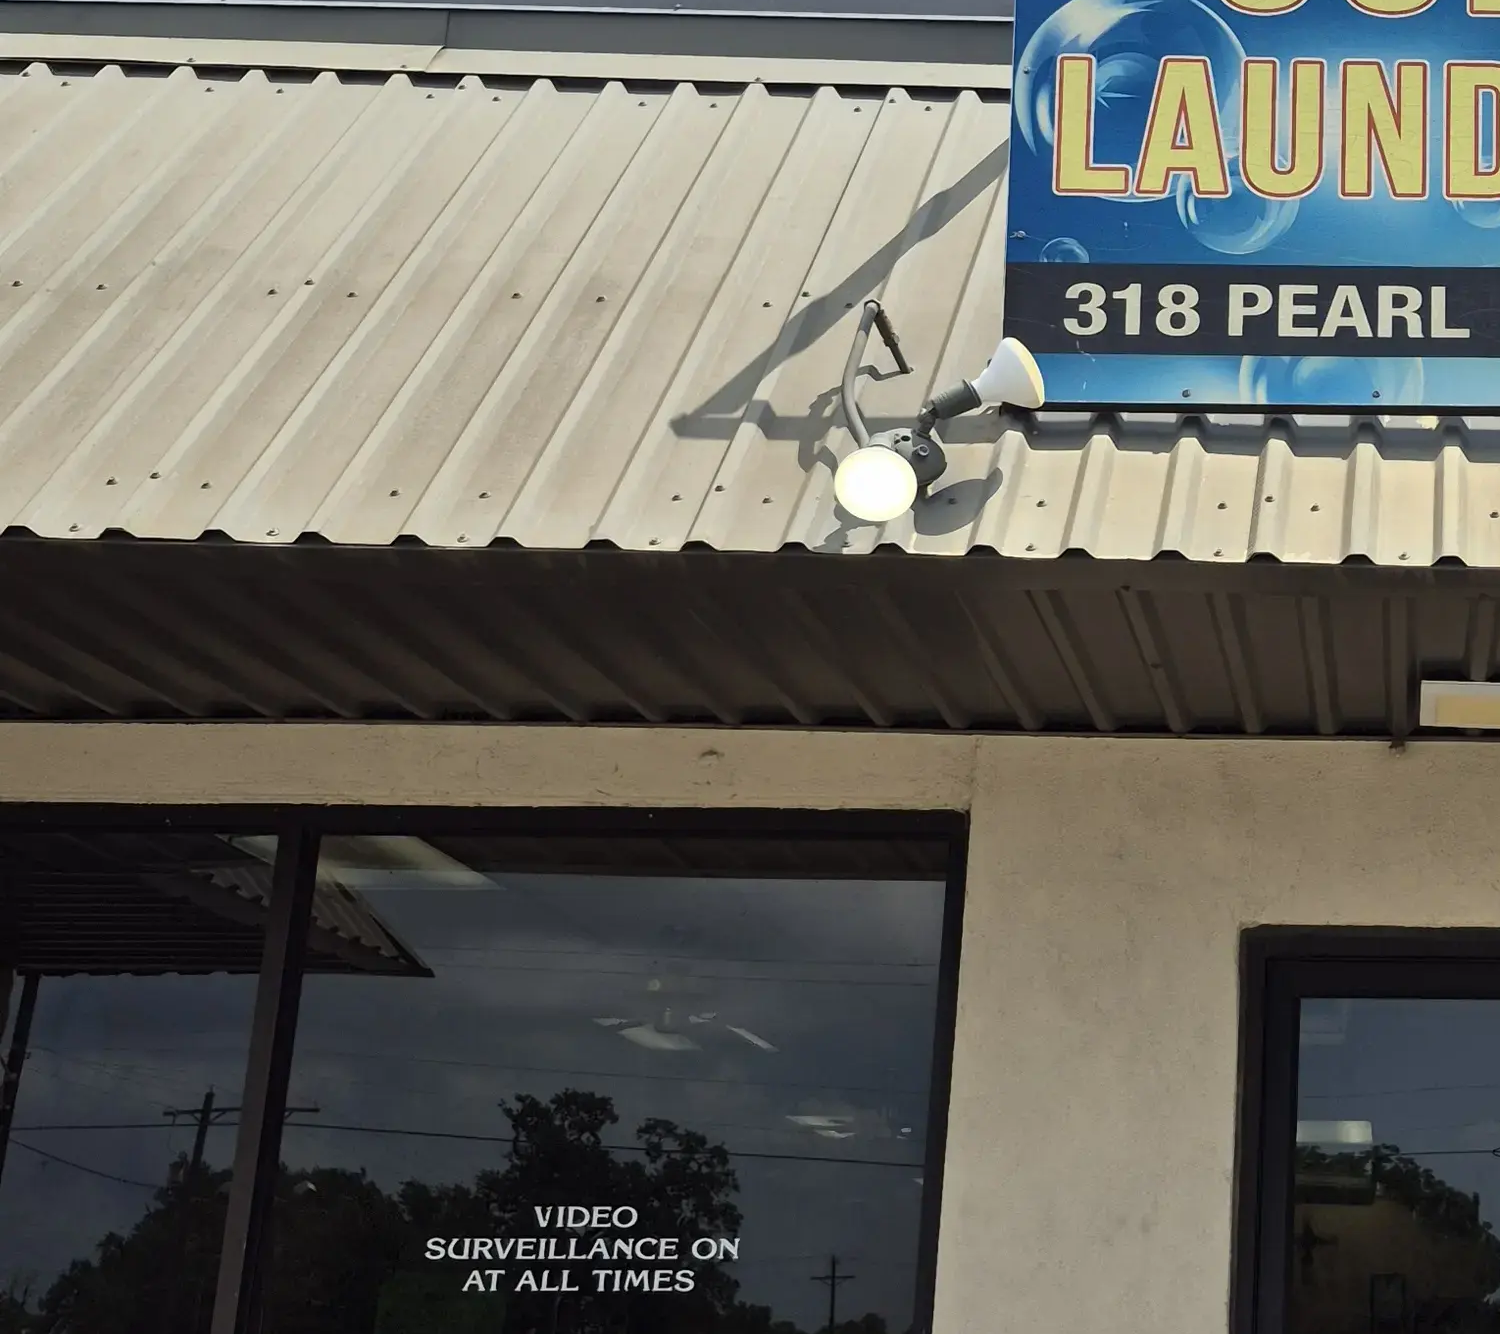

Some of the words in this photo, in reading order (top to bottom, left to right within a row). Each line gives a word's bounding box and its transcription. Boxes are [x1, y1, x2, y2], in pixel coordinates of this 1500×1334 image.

[1062, 282, 1201, 337] 318
[1227, 284, 1471, 340] PEARL
[534, 1205, 639, 1228] VIDEO
[424, 1237, 679, 1261] SURVEILLANCE
[691, 1237, 741, 1260] ON
[461, 1269, 506, 1292] AT
[515, 1269, 579, 1292] ALL
[592, 1269, 696, 1292] TIMES
